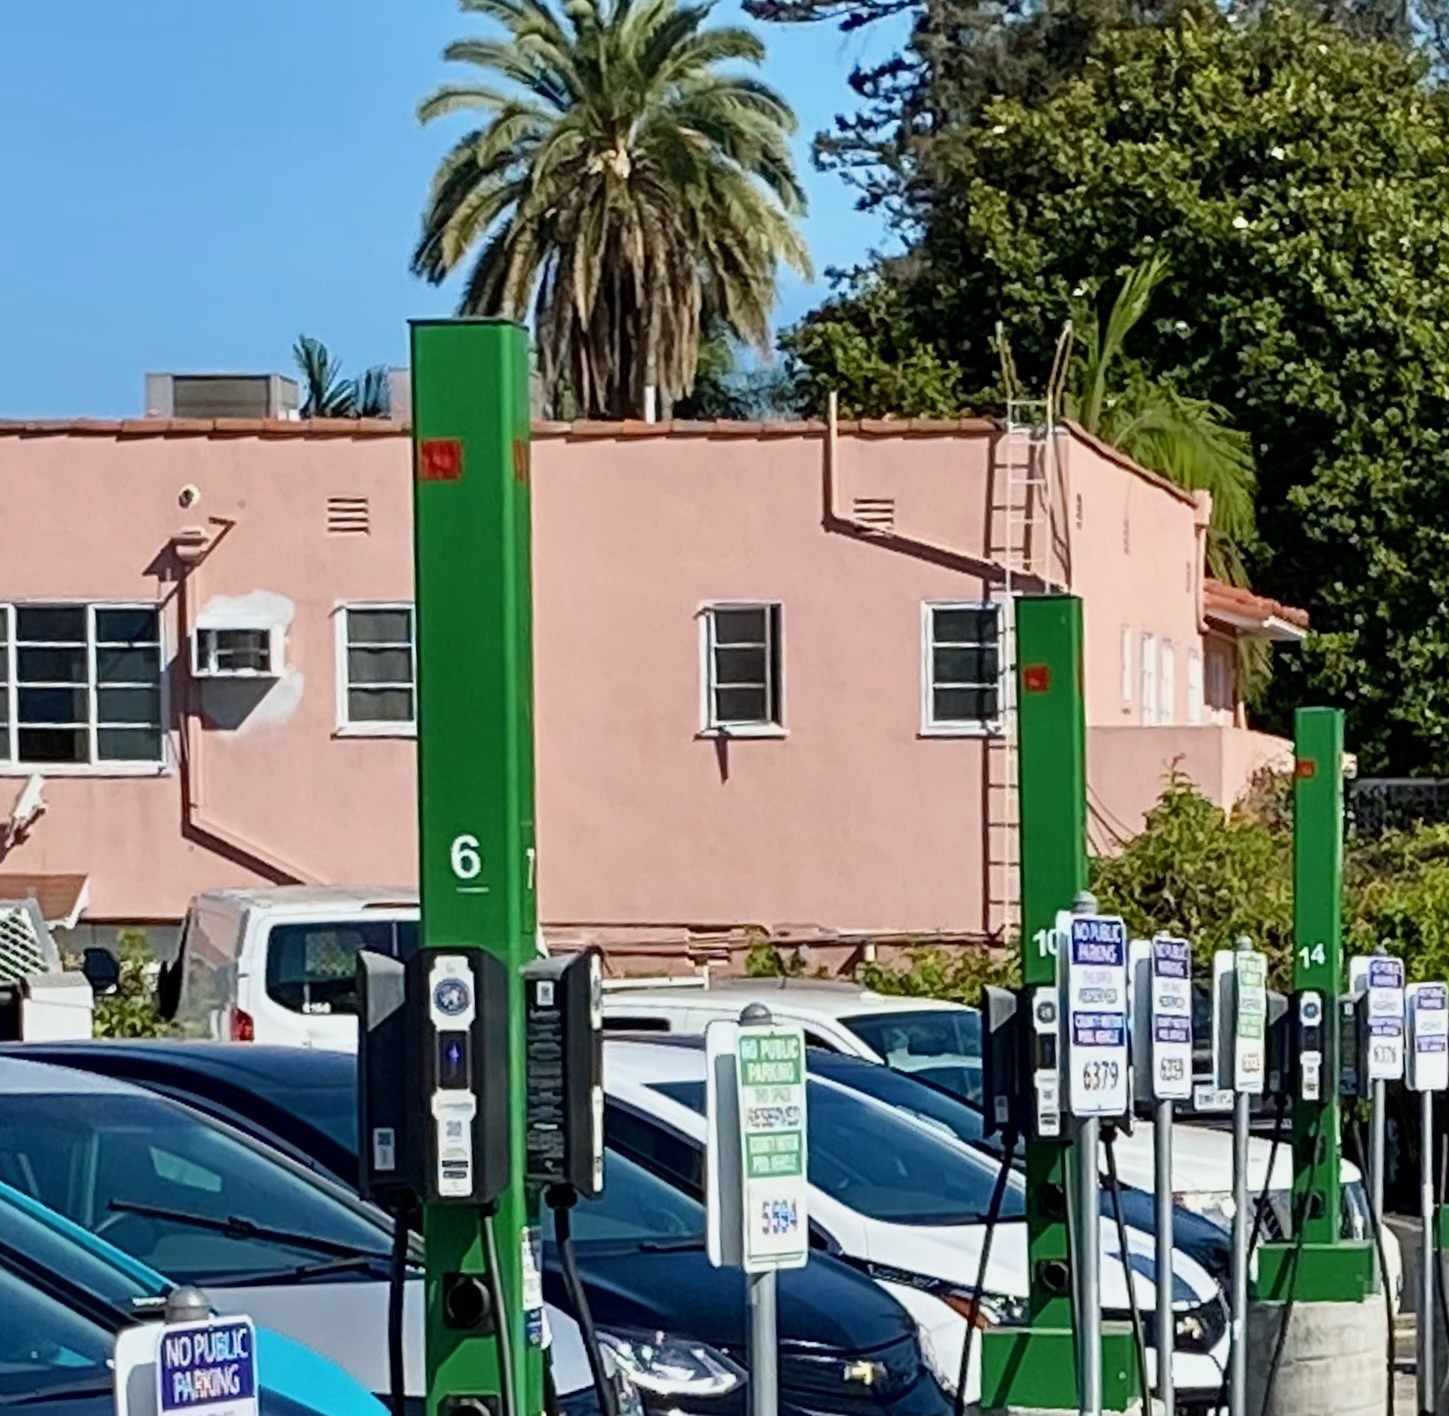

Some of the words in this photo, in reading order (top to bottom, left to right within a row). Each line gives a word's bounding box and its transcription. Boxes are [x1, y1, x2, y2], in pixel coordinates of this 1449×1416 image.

[451, 834, 481, 879] 6
[1032, 928, 1058, 957] 10
[1299, 943, 1326, 969] 14
[1082, 1061, 1119, 1091] 6379
[166, 1335, 192, 1369] NO
[193, 1327, 249, 1364] PUBLIC
[172, 1364, 241, 1404] PARKING
